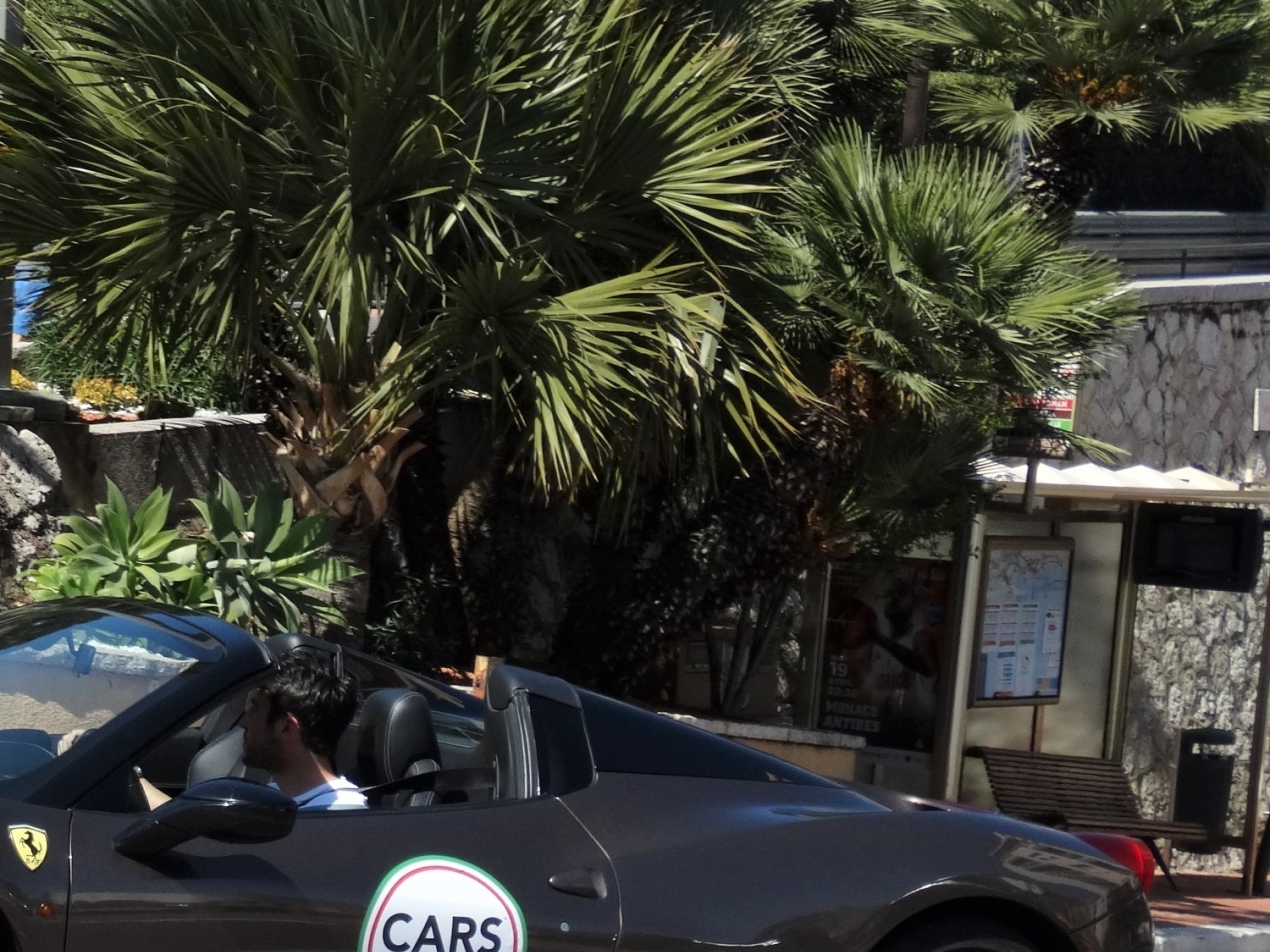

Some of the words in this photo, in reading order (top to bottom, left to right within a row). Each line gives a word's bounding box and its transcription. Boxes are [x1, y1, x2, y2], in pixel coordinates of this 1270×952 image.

[828, 661, 848, 677] 19
[824, 698, 878, 718] MONACO
[822, 714, 881, 733] ANTIBES
